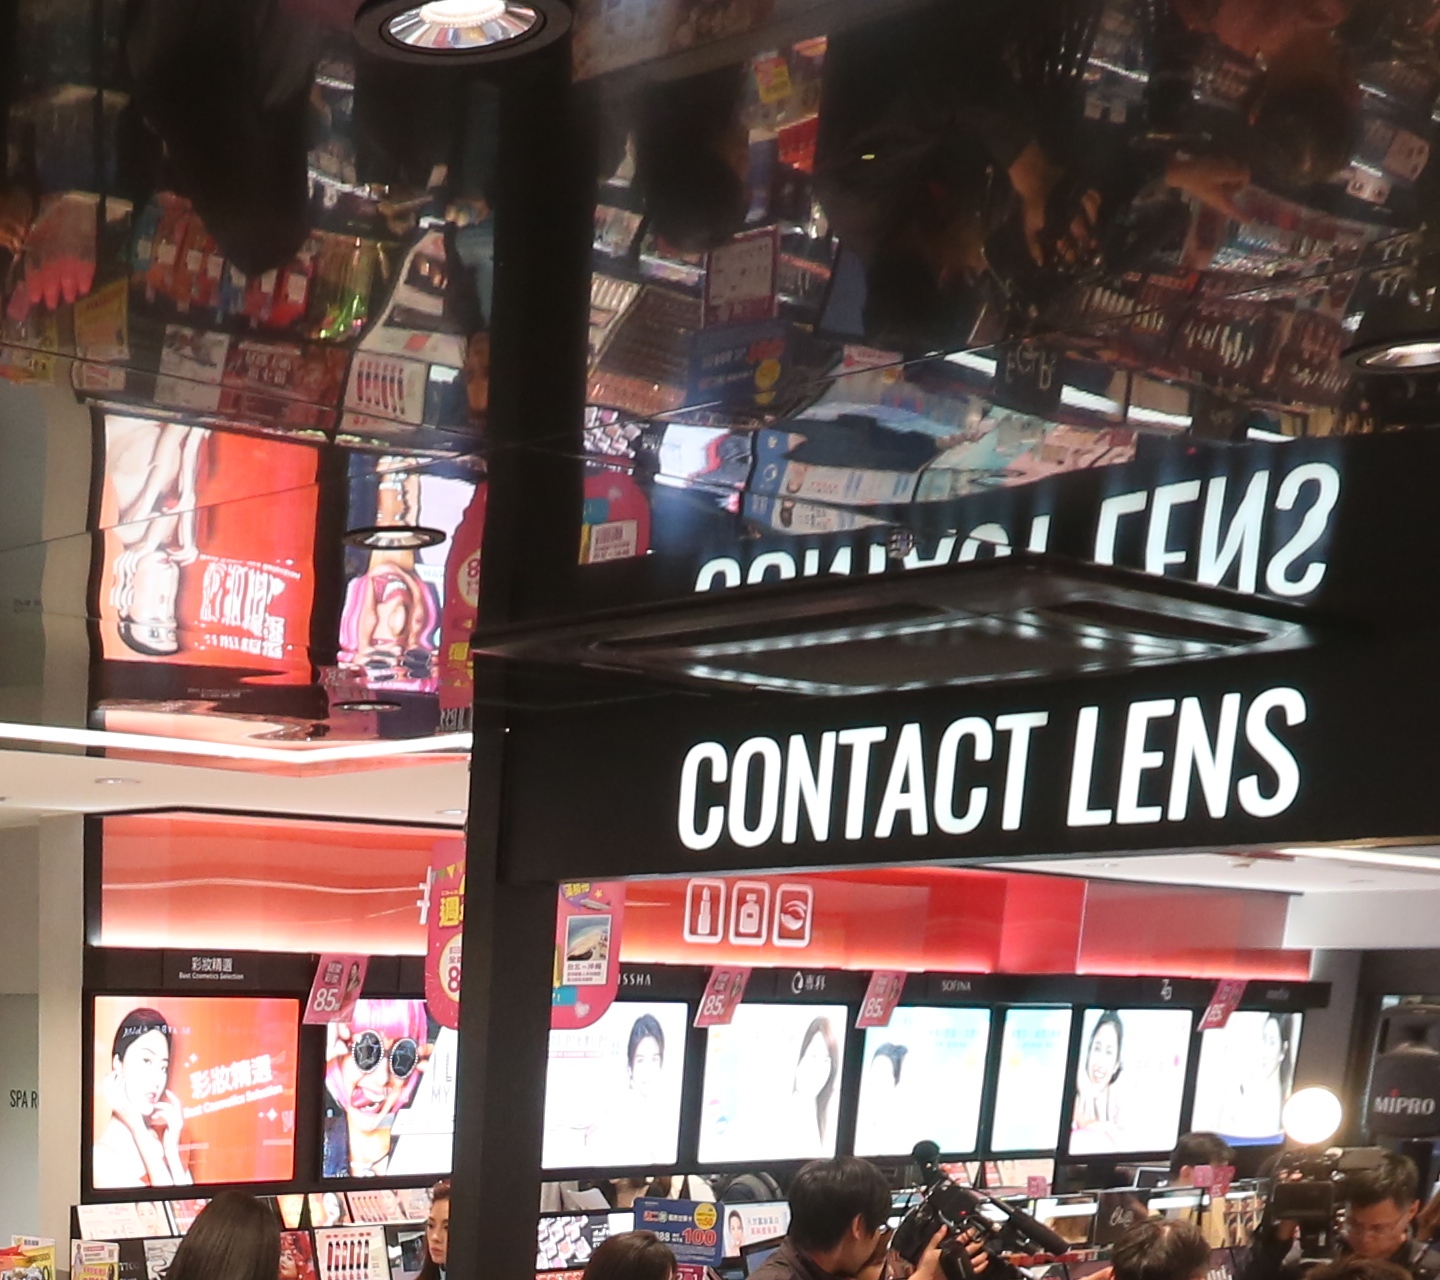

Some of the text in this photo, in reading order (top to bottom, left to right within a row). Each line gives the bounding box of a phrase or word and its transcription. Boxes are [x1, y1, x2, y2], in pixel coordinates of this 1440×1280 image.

[678, 687, 1307, 852] CONTACT LENS
[191, 956, 233, 972] 彩妝精選
[612, 973, 653, 987] ISSHA
[941, 980, 972, 992] SOFINA
[190, 1055, 273, 1100] 彩妝精選
[1373, 1094, 1435, 1115] MIPRO
[681, 1226, 717, 1246] 100
